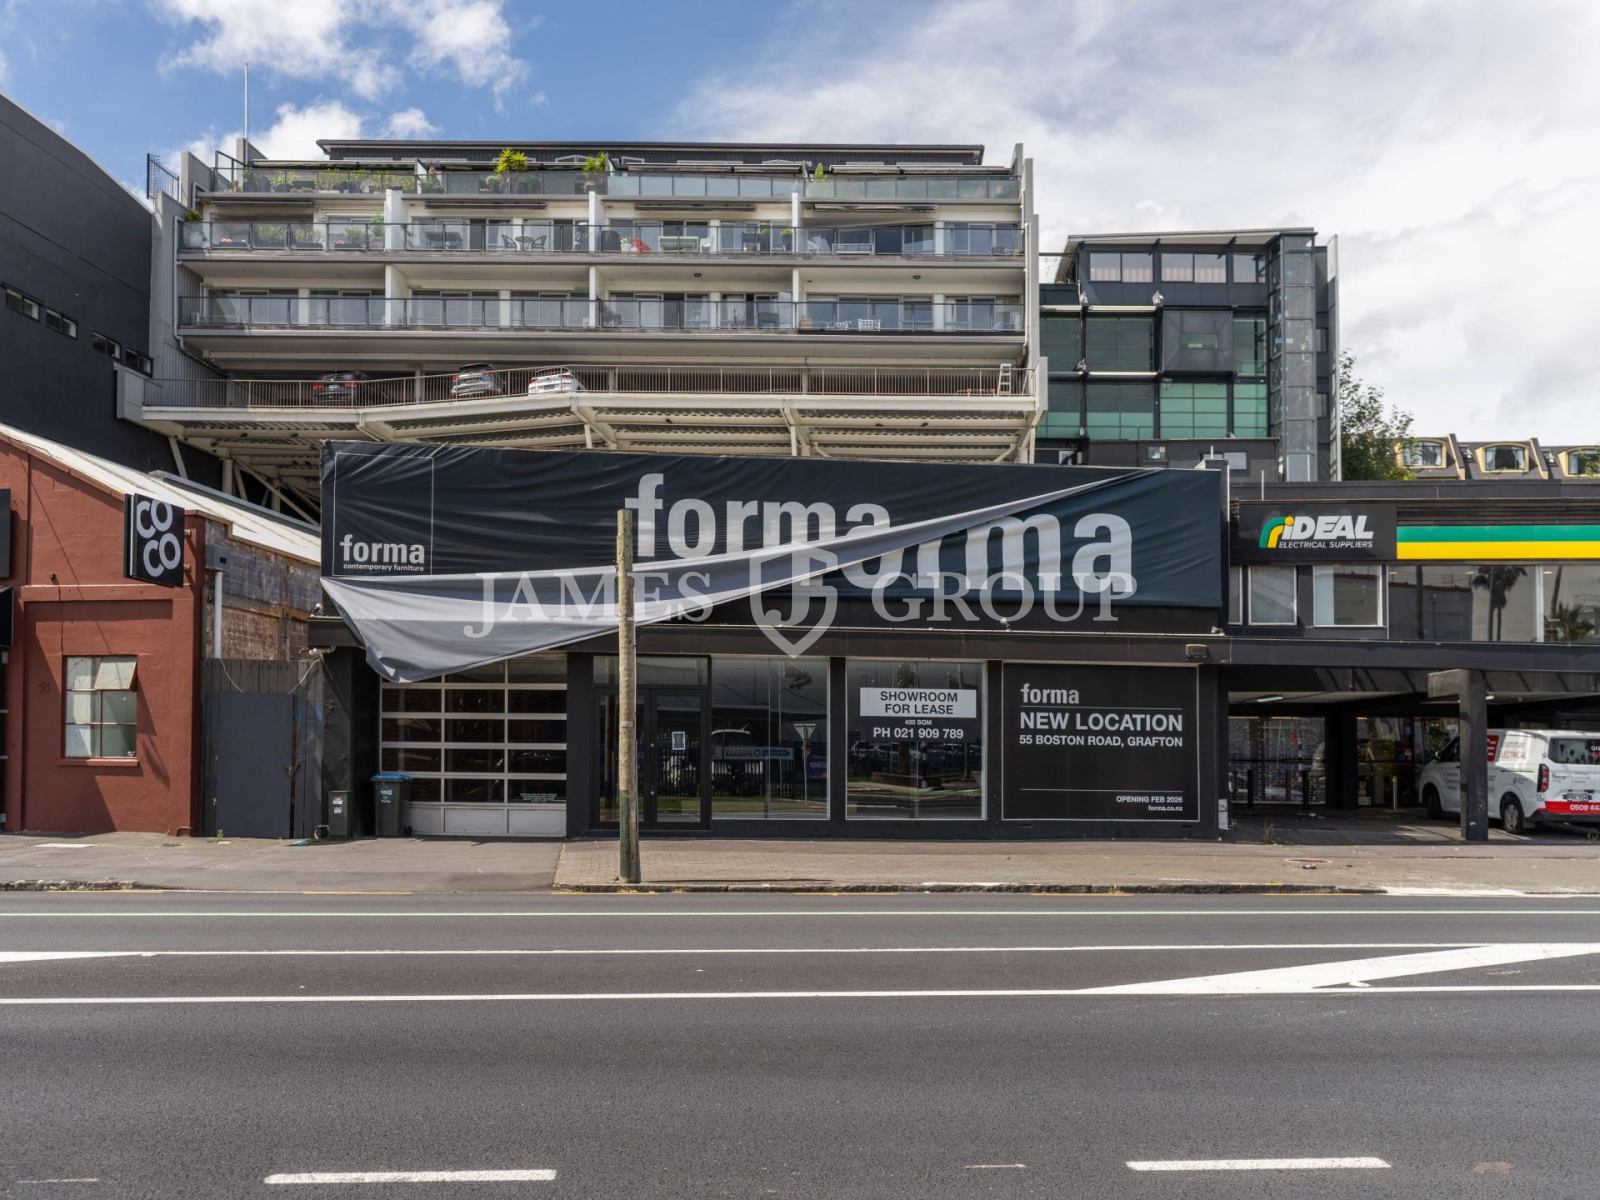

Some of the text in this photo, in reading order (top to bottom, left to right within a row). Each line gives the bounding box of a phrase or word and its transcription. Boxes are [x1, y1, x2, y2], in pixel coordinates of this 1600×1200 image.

[339, 533, 425, 564] forma
[1278, 541, 1373, 549] ELECTRICAL SUPPLIERS
[343, 563, 425, 572] contemporary furniture
[880, 690, 958, 703] SHOWROOM
[1020, 683, 1080, 704] forma
[885, 703, 954, 715] FOR LEASE
[1020, 712, 1183, 732] NEW LOCATION
[873, 727, 964, 739] PH 021 909 789
[1019, 734, 1183, 748] 55 BOSTON ROAD, GRAFTON
[1116, 795, 1150, 803] OPENING
